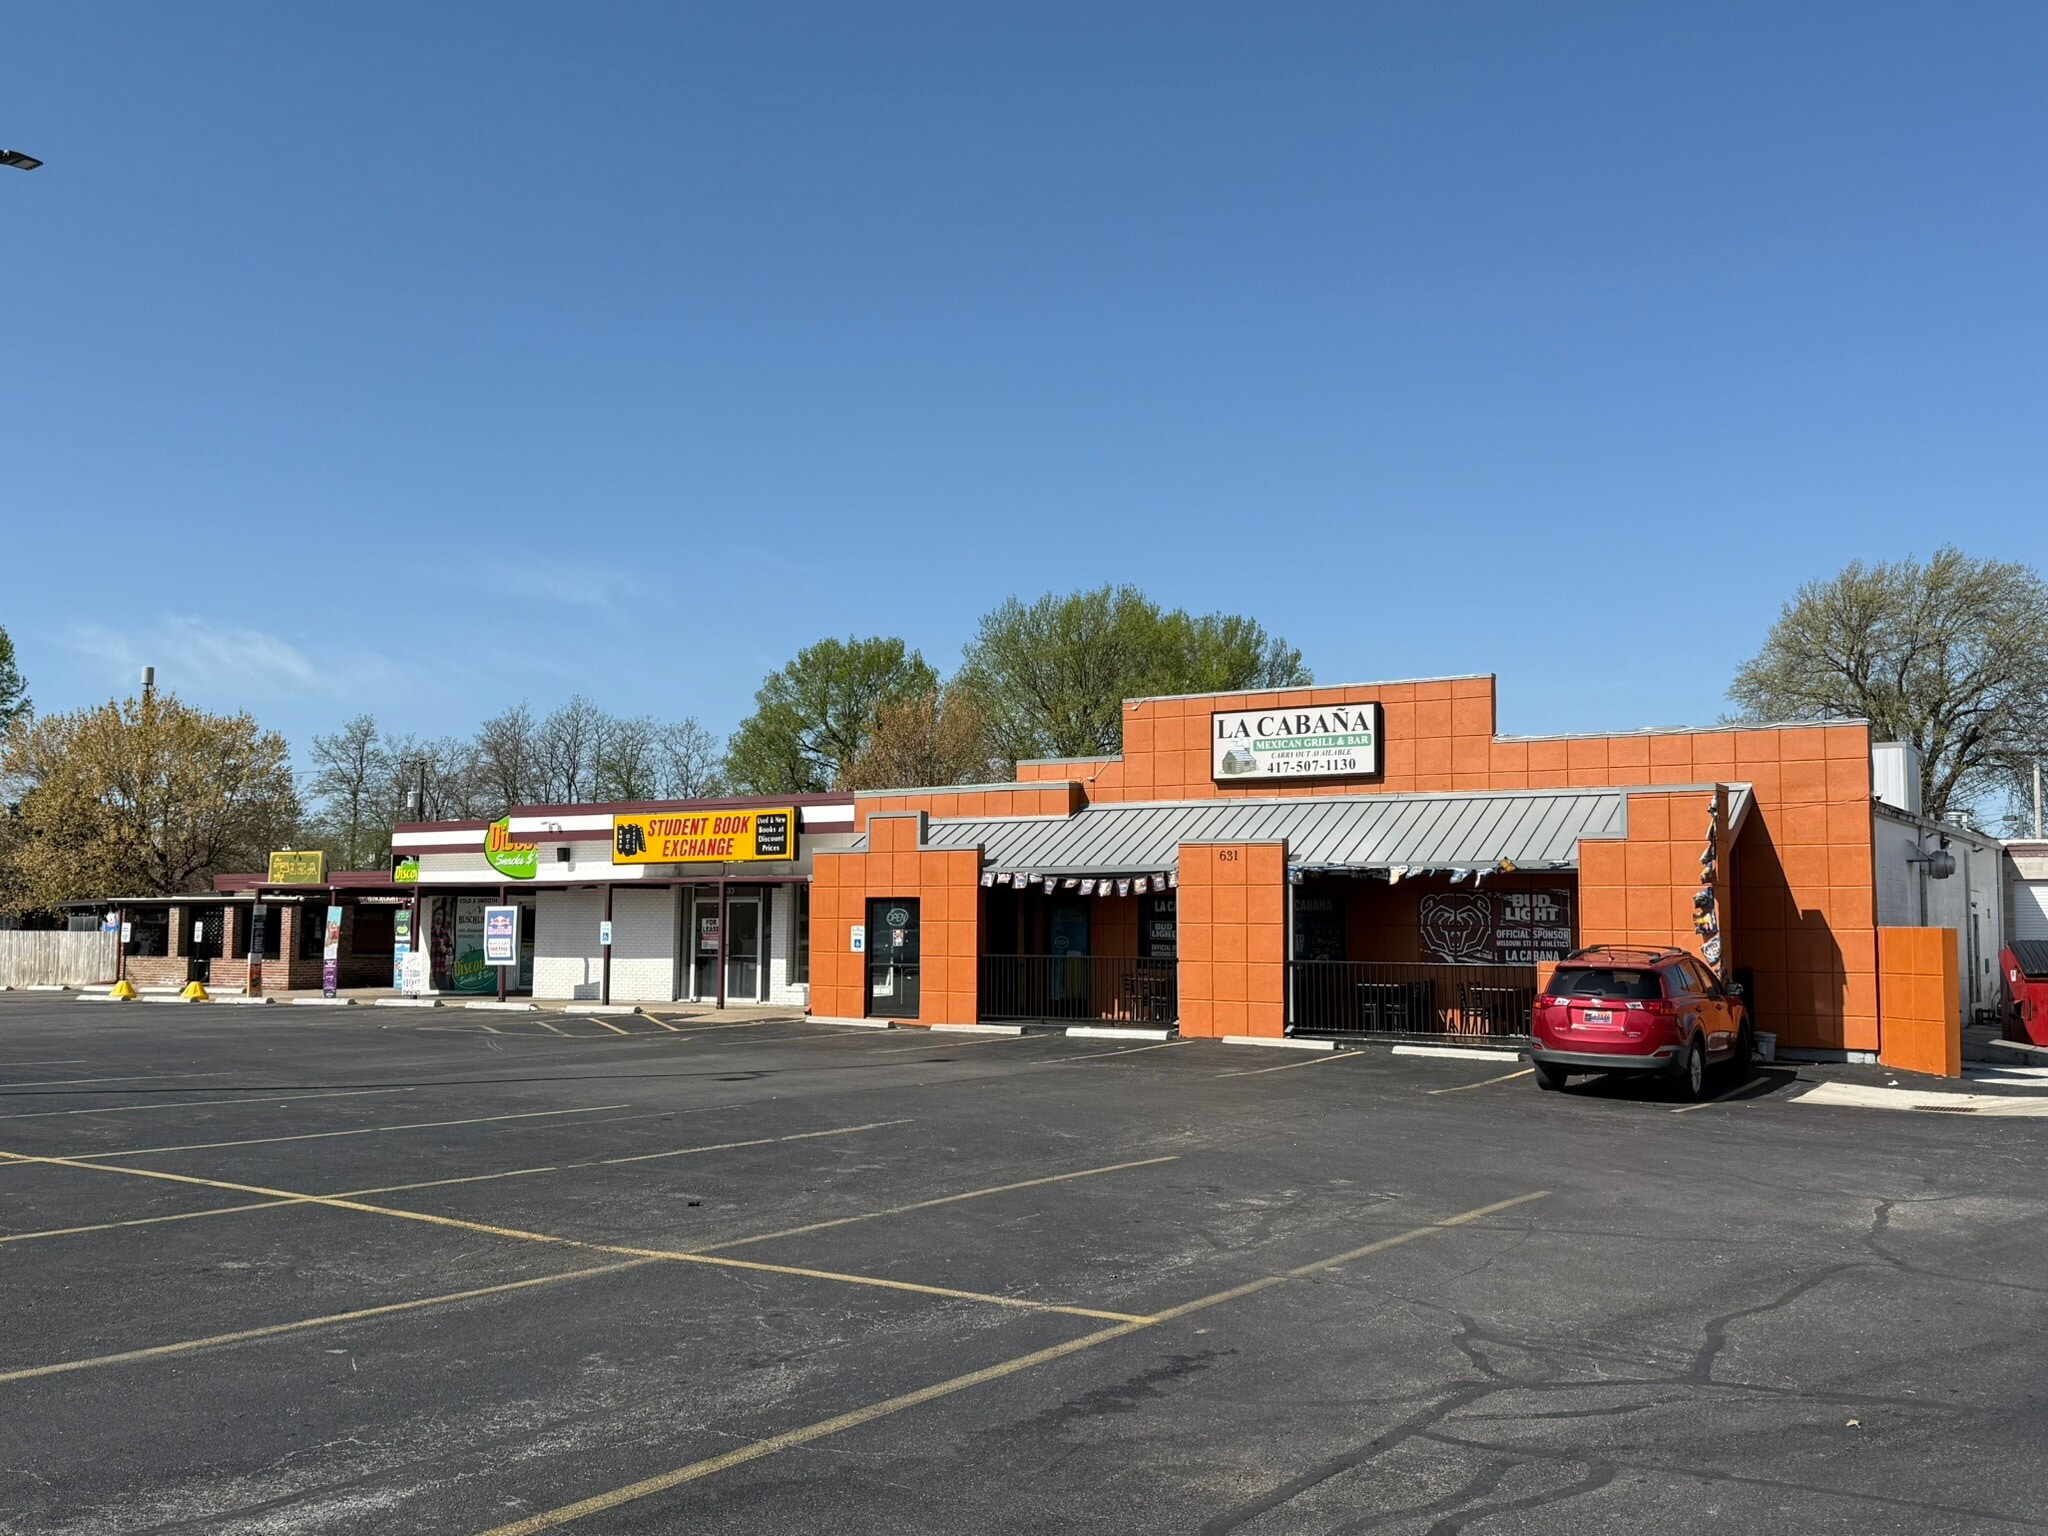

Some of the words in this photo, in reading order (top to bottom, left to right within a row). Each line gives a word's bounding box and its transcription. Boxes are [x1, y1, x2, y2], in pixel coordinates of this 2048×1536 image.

[1217, 718, 1251, 739] LA
[1257, 708, 1370, 737] CABAÑA
[1256, 739, 1302, 750] MEXICAN
[1303, 737, 1335, 748] GRILL
[1336, 736, 1345, 746] &
[1347, 735, 1369, 745] BAR
[1271, 751, 1294, 759] CARRY
[1295, 750, 1312, 758] OUT
[1312, 749, 1353, 757] AVAILABLE
[1267, 758, 1356, 773] 417-507-1130
[648, 817, 709, 836] STUDENT
[713, 816, 751, 834] BOOK
[770, 816, 774, 824] &
[758, 835, 785, 843] Discount
[663, 838, 735, 857] EXCHANGE
[762, 844, 780, 852] Prices
[1219, 850, 1238, 862] 631
[1154, 900, 1166, 912] LA
[1512, 894, 1551, 907] BUD
[1505, 907, 1558, 921] LIGHT
[1496, 929, 1530, 940] OFFICIAL
[1532, 930, 1569, 940] SPONSOR
[1522, 940, 1540, 948] STTE
[1540, 940, 1569, 948] ATHLETICS
[1505, 949, 1518, 961] LA
[1519, 950, 1560, 962] CABANA
